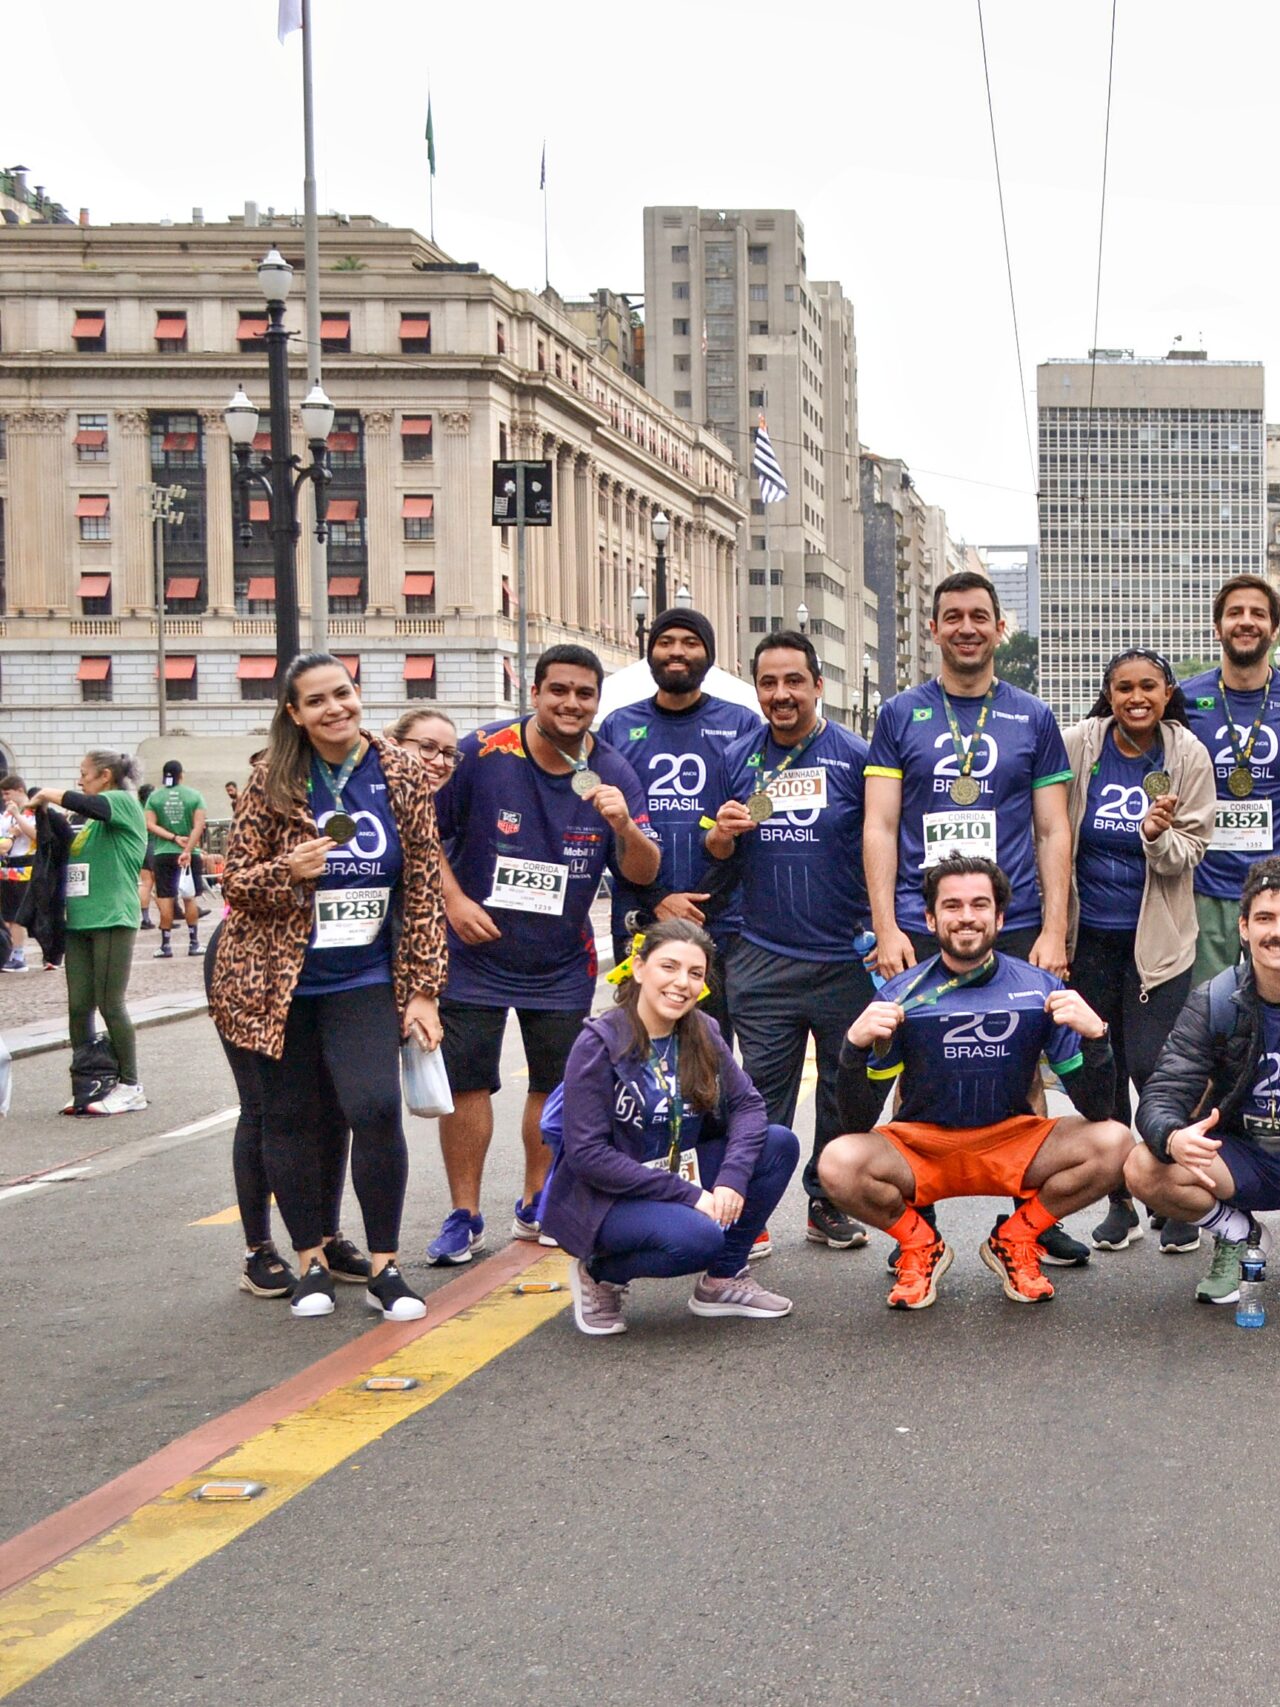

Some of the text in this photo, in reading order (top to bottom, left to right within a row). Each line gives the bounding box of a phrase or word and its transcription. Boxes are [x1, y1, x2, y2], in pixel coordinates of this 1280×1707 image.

[1215, 723, 1279, 765] 20
[933, 732, 998, 778] 20
[648, 753, 707, 796] 20
[648, 797, 705, 811] BRASIL
[1094, 783, 1149, 821] 20
[1230, 803, 1264, 811] CORRIDA
[948, 812, 986, 821] CORRIDA
[1215, 811, 1263, 828] 1352
[761, 828, 820, 842] BRASIL
[932, 822, 985, 841] 1210
[523, 861, 560, 874] CORRIDA
[504, 869, 556, 891] 1239
[345, 889, 383, 900] CORRIDA
[326, 901, 381, 920] 1253
[939, 1009, 1020, 1043] 20
[944, 1045, 1011, 1059] BRASIL
